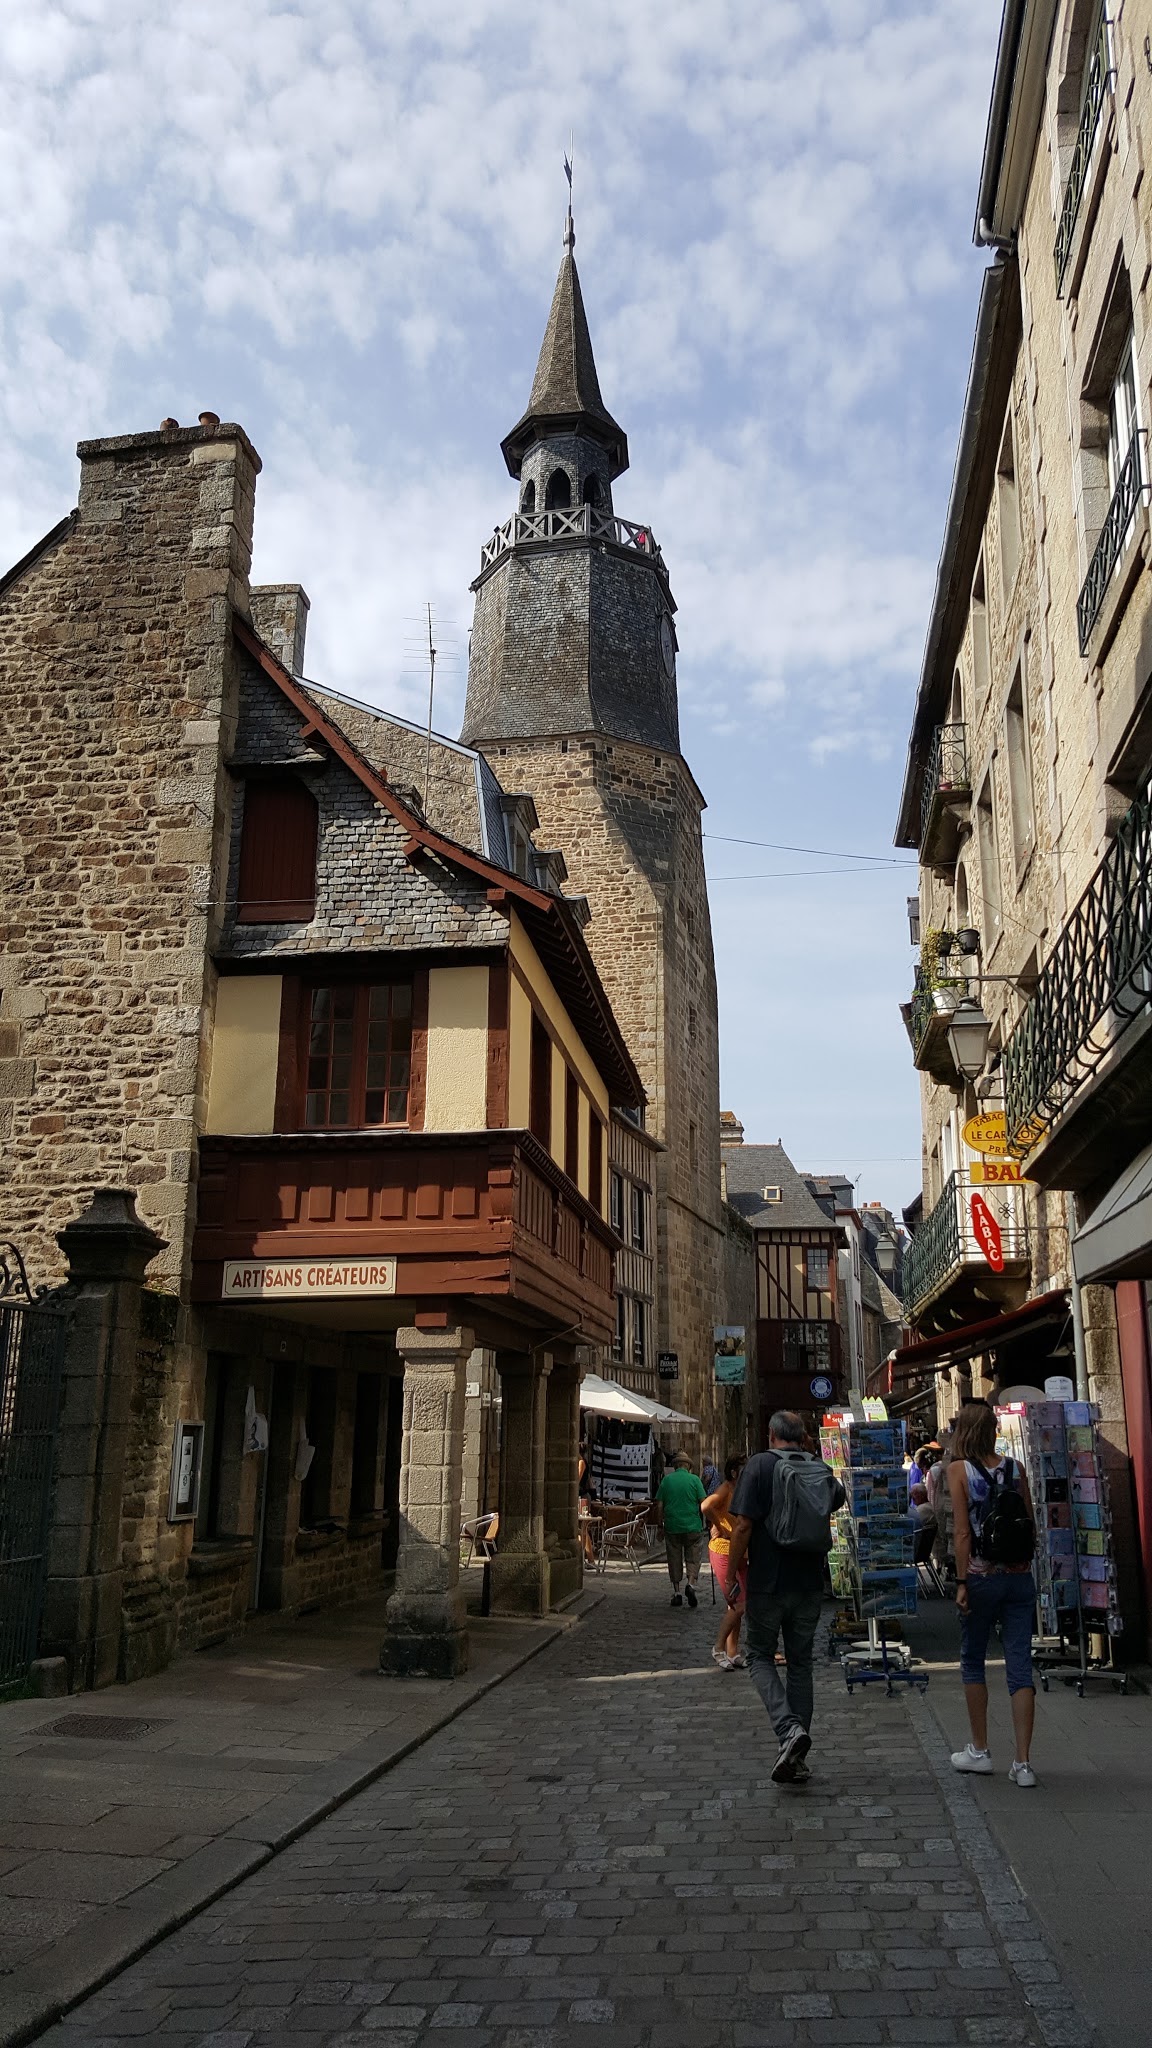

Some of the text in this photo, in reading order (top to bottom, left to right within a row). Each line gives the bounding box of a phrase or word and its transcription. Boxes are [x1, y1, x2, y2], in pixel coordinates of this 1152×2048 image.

[973, 1113, 1003, 1127] TABAC
[971, 1130, 1039, 1139] LE CARLON
[988, 1144, 1020, 1154] PRES
[974, 1203, 1000, 1261] TABAC
[231, 1263, 388, 1288] ARTISANS CRÉATEURS
